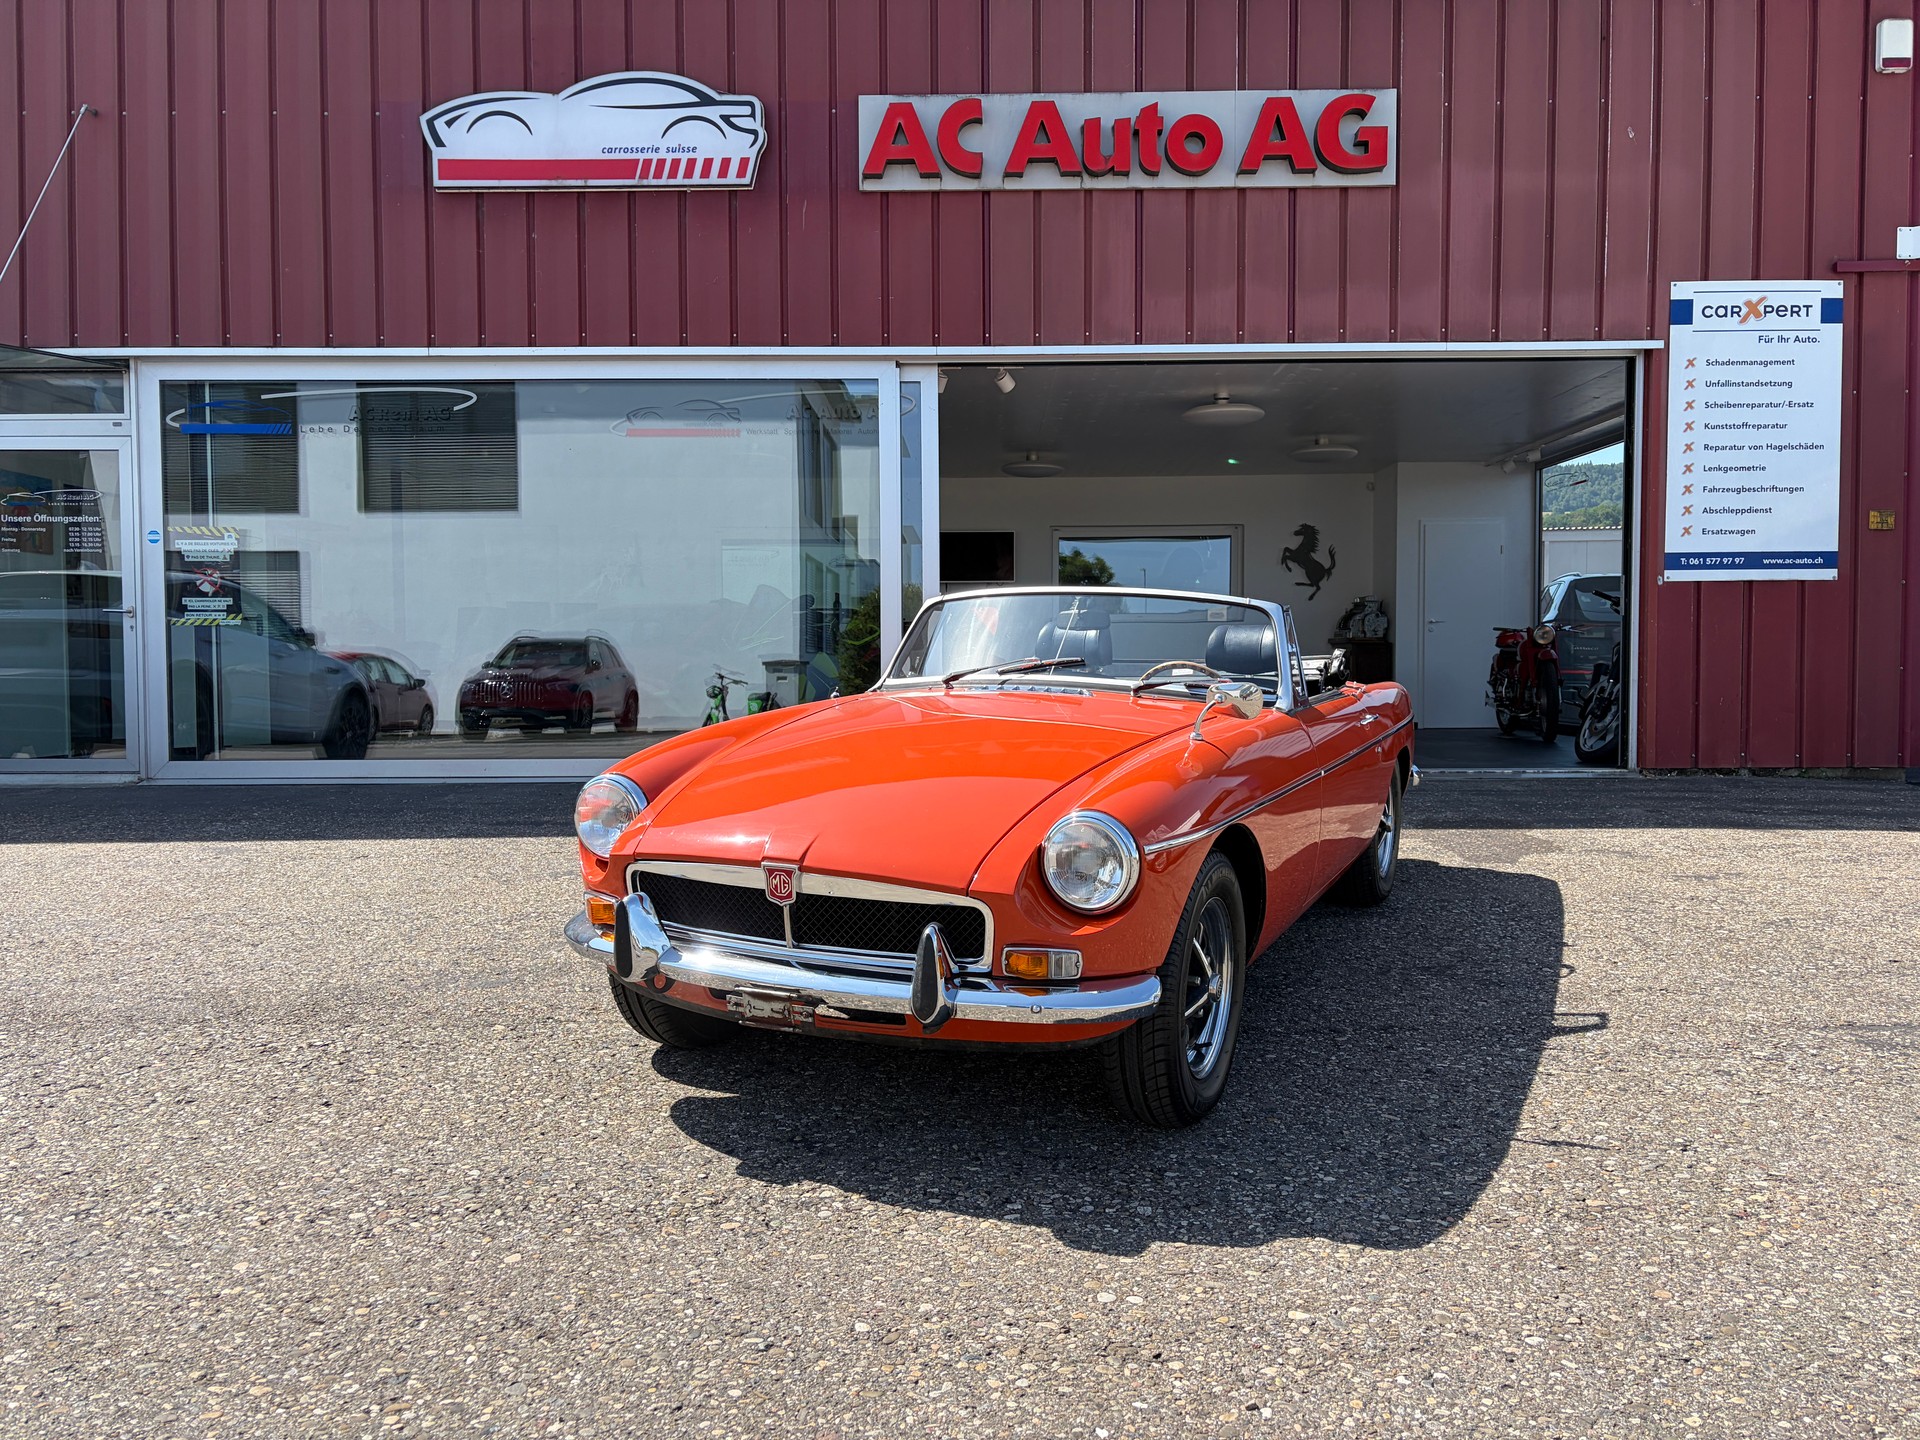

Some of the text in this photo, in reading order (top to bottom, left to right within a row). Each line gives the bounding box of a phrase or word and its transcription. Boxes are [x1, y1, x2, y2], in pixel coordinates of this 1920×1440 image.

[862, 94, 1389, 180] AC Auto AG
[601, 143, 698, 154] carrosserie suisse
[1758, 335, 1821, 344] Für Ihr Auto.
[1705, 358, 1796, 368] Schadenmanagement
[1705, 380, 1793, 389] Unfallinstandsetzung
[1704, 400, 1815, 410] Scheibenreparatur/-Ersatz
[866, 403, 879, 419] A
[300, 425, 334, 433] Lebe
[343, 424, 392, 433] Denen
[1704, 422, 1788, 431] Kunststoffreparatur
[1703, 443, 1745, 453] Reparatur
[1766, 443, 1825, 452] Hagelschäden
[1703, 464, 1767, 474] Lenkgeometrie
[1702, 485, 1805, 495] Fahrzeugbeschriftungen
[1702, 506, 1773, 516] Abschleppdienst
[0, 513, 102, 524] Unsere Öffnungszeiten:
[1701, 527, 1756, 537] Ersatzwagen
[1689, 557, 1704, 565] 061
[1706, 557, 1721, 565] 577
[1722, 557, 1733, 565] 97
[1734, 557, 1745, 565] 97
[1762, 556, 1824, 564] www.ac-auto.ch
[772, 874, 789, 894] MG
